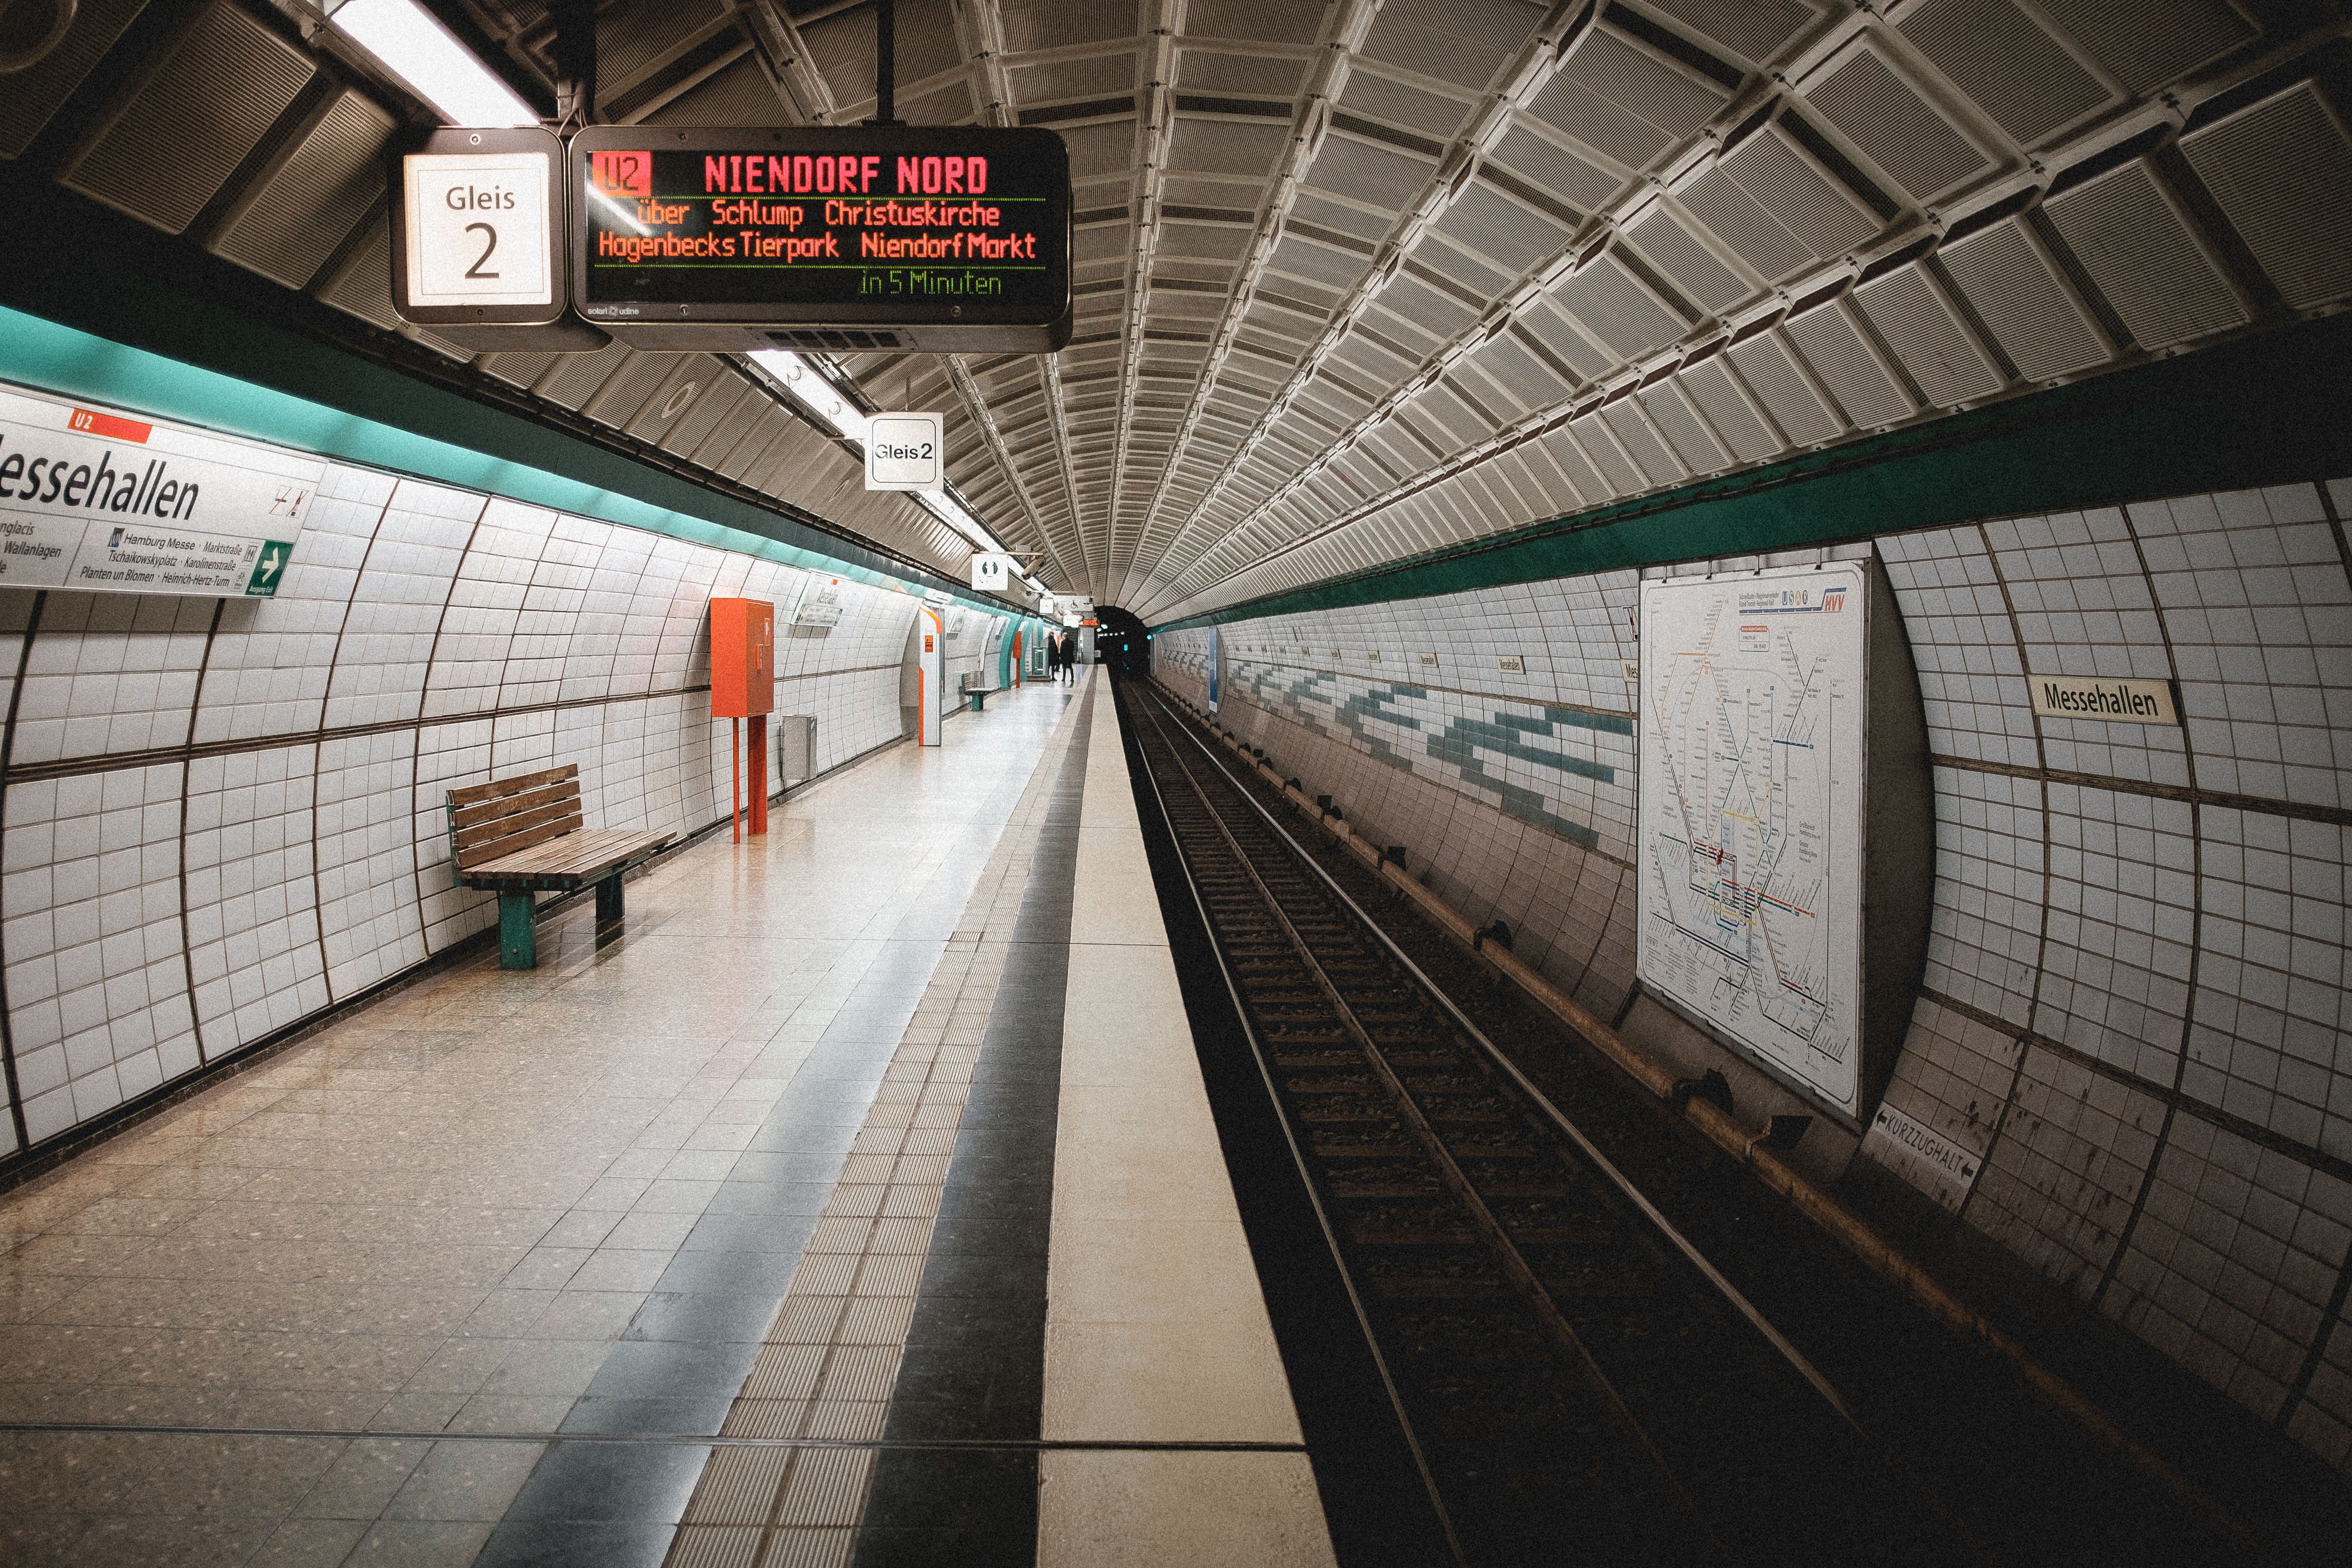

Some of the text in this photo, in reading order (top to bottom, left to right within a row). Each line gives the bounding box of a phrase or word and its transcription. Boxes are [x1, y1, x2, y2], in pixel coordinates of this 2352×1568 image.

[604, 155, 988, 193] U2 NIENDORF NORD
[446, 185, 515, 210] Gleis
[637, 199, 1000, 232] über Schlump Christuskirche
[465, 222, 499, 279] 2
[599, 231, 1036, 264] Hagenbecks Tierpark Niendorf Markt
[860, 270, 1001, 295] in 5 Minuten
[74, 412, 93, 430] U2
[921, 443, 933, 459] 2
[0, 434, 199, 520] essehallen
[4, 540, 62, 560] Wallanlagen
[123, 533, 242, 556] Hamburg Messe Marktstraße
[108, 550, 236, 571] Tschaikowskyplatz Karolinenstraße
[80, 566, 112, 580] Planten
[113, 571, 123, 580] un
[125, 570, 155, 583] Blomen
[161, 574, 230, 587] Heinrich-Hertz-Turm
[1824, 594, 1845, 611] HVV
[2043, 683, 2159, 716] Messehallen
[1885, 1114, 1964, 1173] KURZZUGHALT
